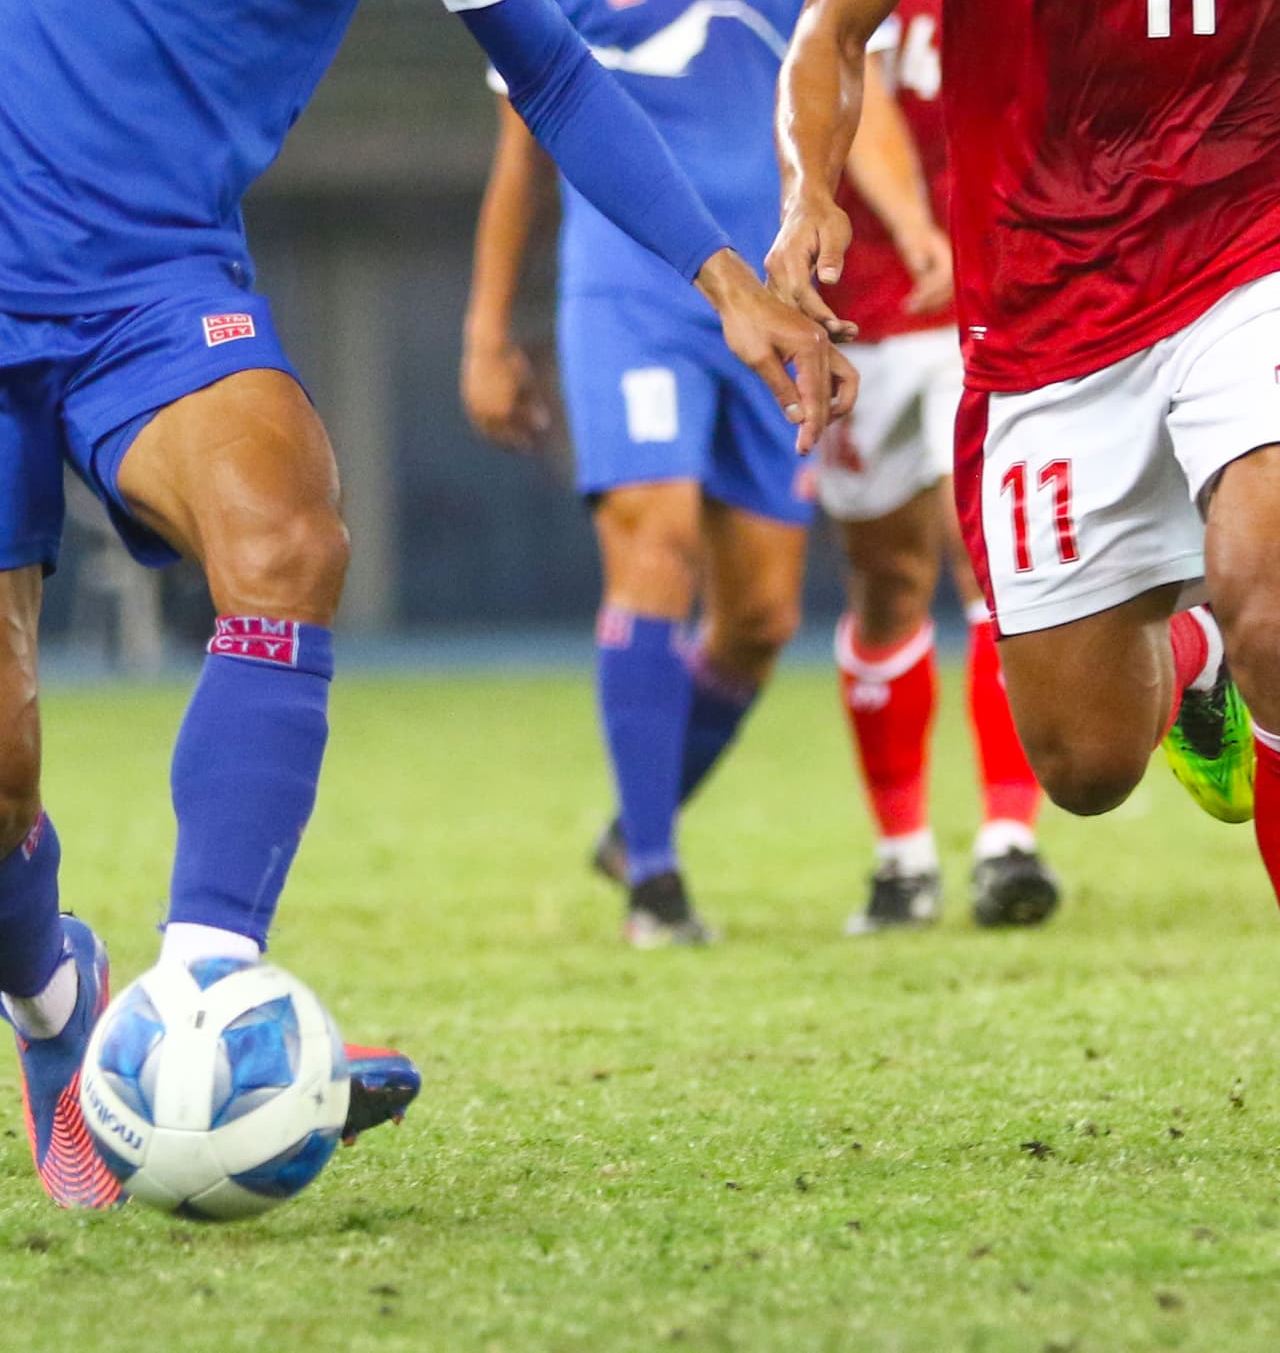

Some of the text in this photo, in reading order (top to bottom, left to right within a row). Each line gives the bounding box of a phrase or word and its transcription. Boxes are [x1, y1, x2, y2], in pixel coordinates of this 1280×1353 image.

[210, 315, 248, 325] KTM
[212, 327, 247, 339] CTY
[1000, 458, 1080, 573] 11
[220, 617, 286, 635] KTM
[215, 636, 282, 656] CTY
